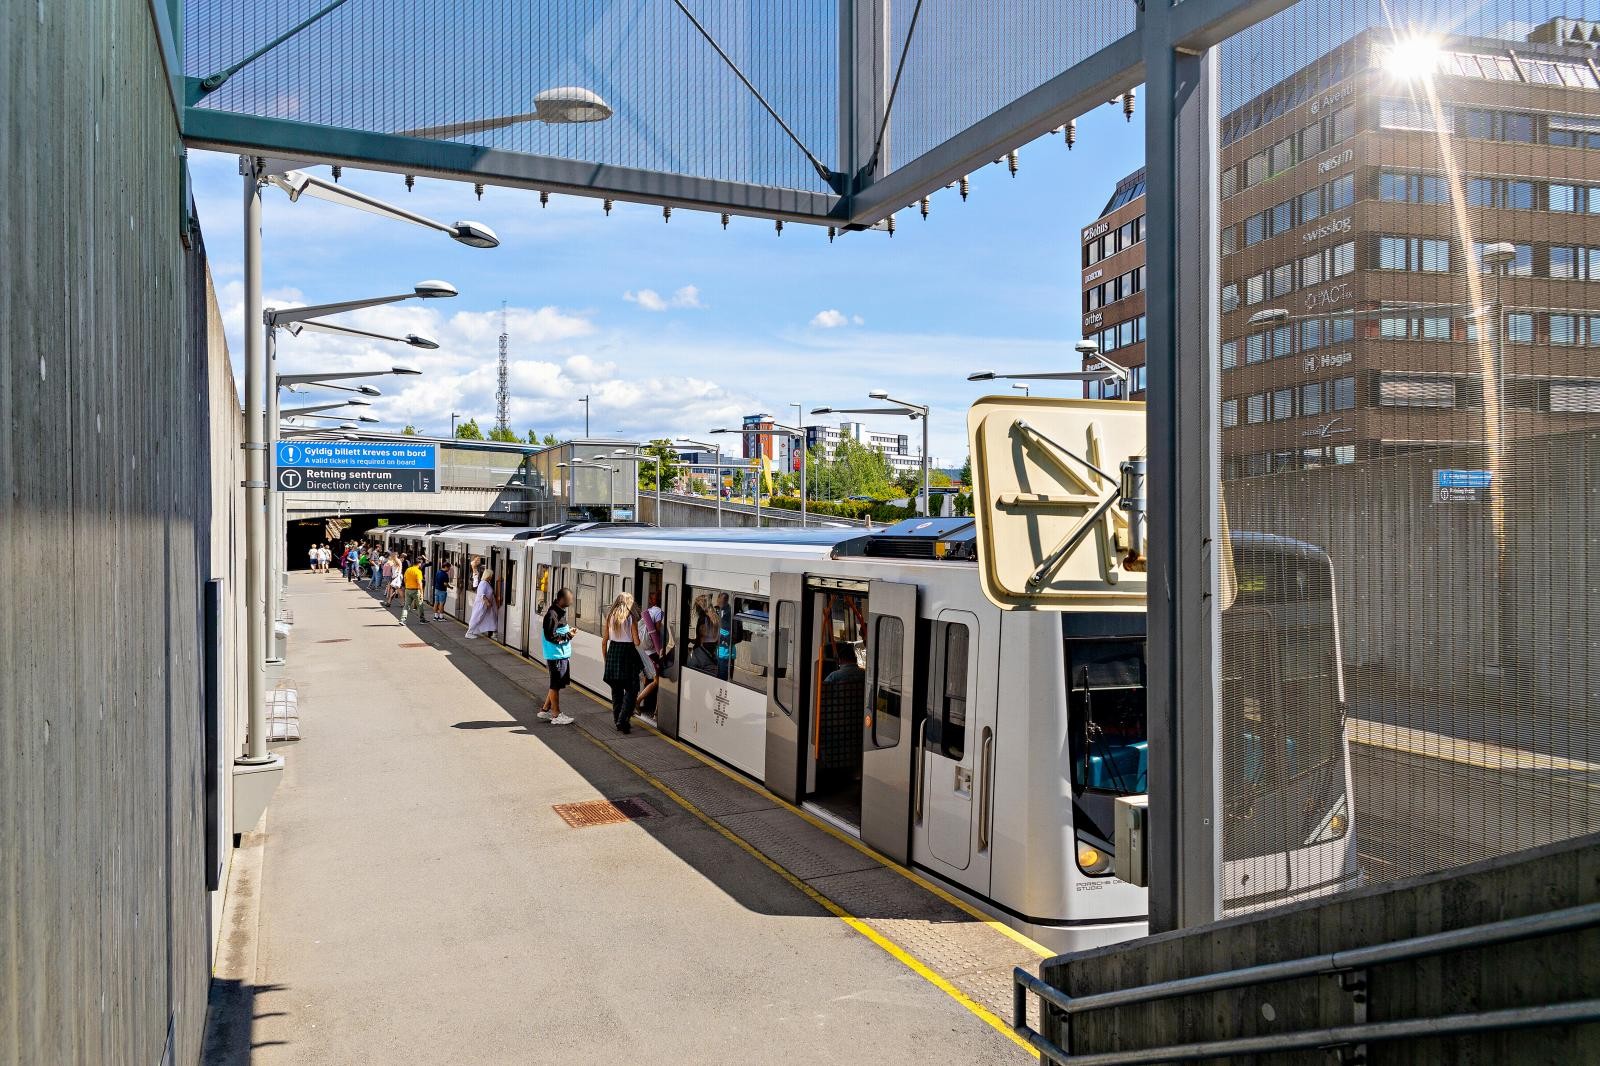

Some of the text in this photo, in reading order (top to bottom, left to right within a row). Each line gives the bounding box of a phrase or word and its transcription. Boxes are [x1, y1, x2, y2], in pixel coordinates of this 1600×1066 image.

[1088, 222, 1108, 239] Bohus
[304, 447, 333, 456] Gyldig
[335, 448, 360, 456] billett
[306, 469, 392, 480] Retning sentrum
[306, 480, 403, 491] Direction city centre
